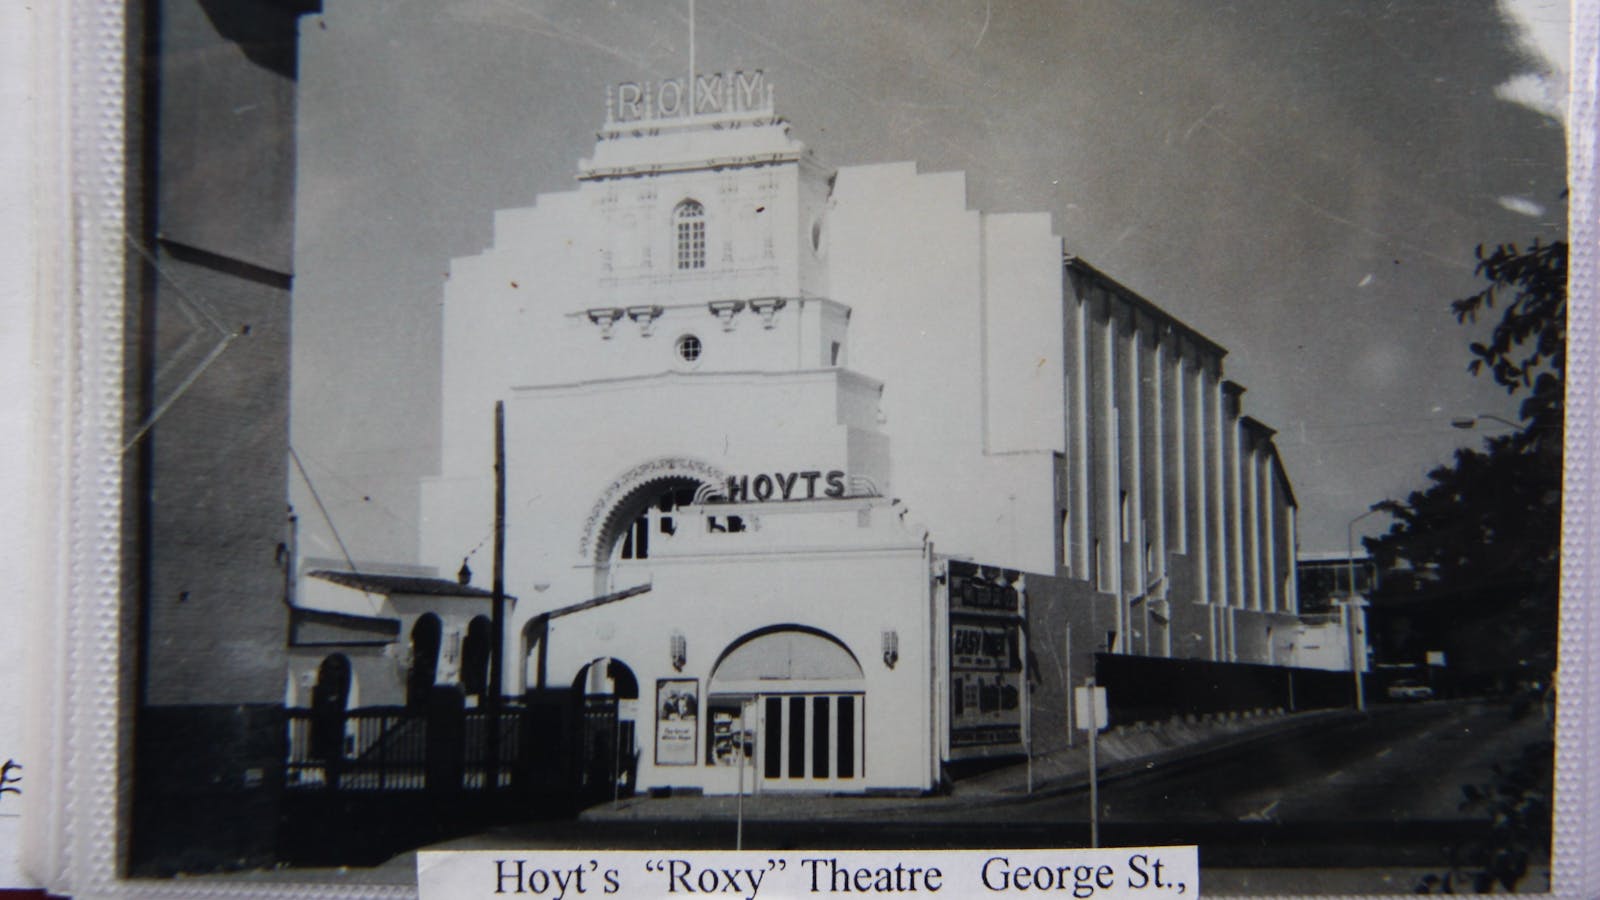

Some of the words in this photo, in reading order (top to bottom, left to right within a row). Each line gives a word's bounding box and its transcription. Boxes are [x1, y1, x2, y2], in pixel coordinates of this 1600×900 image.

[617, 69, 765, 122] ROXY
[727, 470, 846, 502] HOYTS
[801, 858, 943, 892] Theatre
[981, 855, 1115, 899] George
[1127, 853, 1187, 894] St.,
